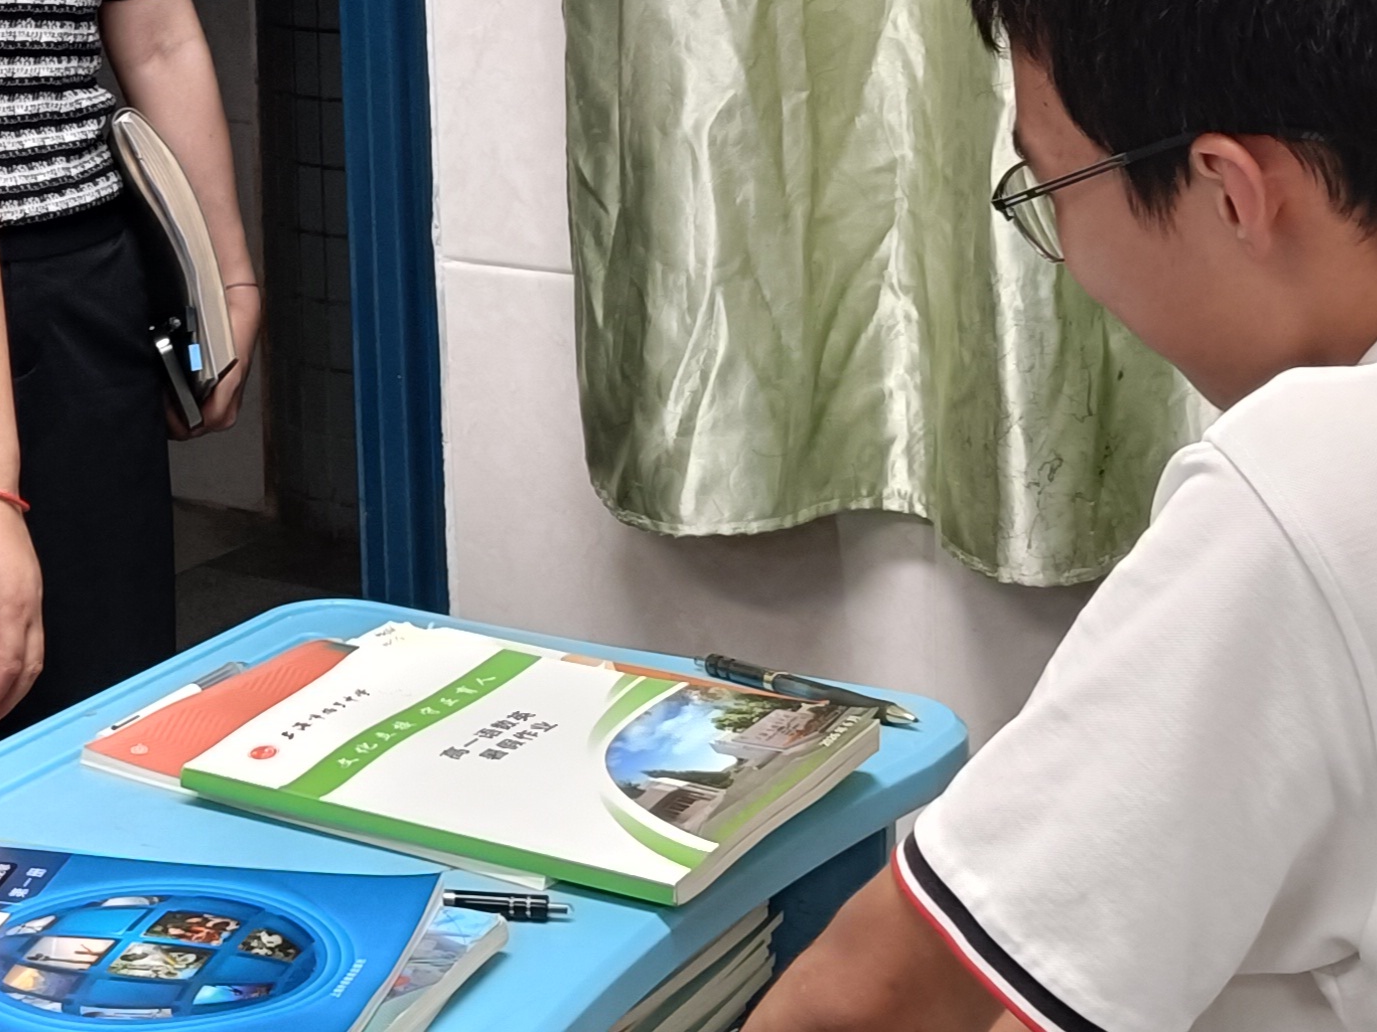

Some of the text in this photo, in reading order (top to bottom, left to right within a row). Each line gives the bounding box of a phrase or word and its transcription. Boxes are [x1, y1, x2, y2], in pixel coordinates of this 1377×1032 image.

[439, 711, 536, 760] 高一语数英
[479, 721, 558, 760] 暑假作业
